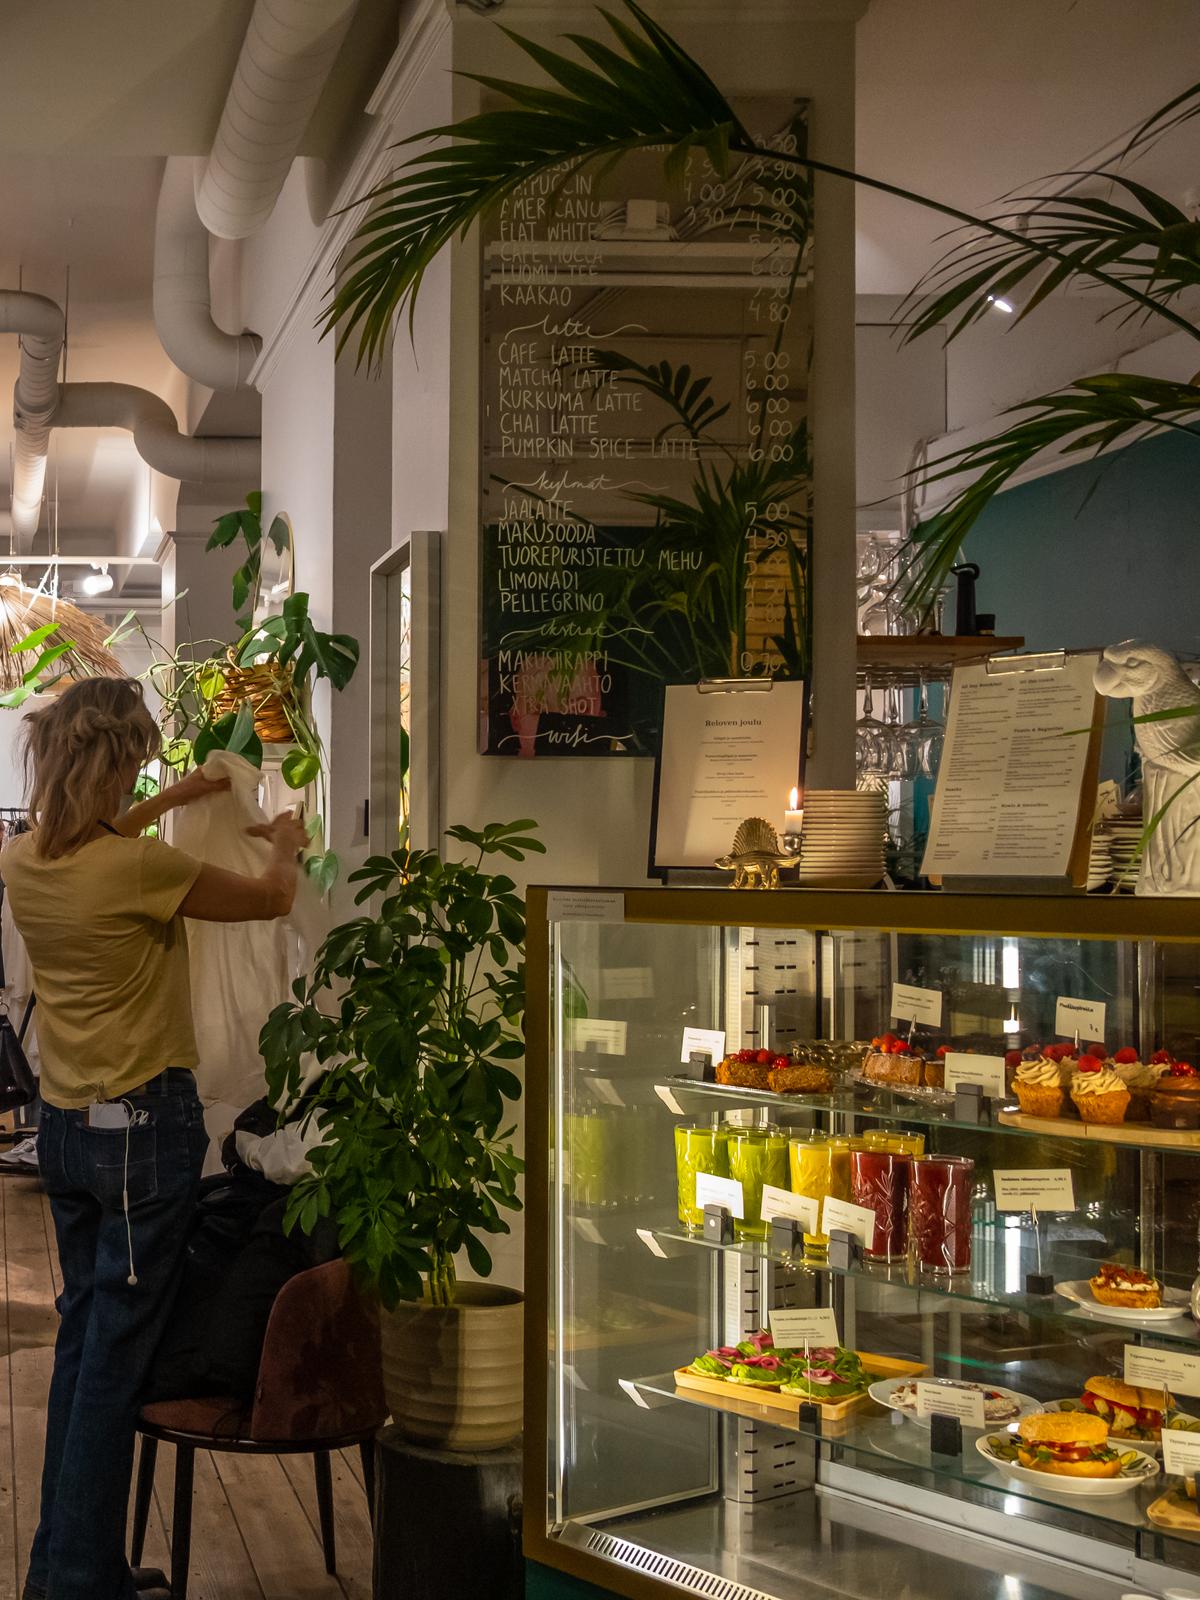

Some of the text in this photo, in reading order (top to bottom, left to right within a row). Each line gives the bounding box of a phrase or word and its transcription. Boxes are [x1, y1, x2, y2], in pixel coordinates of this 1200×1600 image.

[500, 220, 599, 242] FLAT WHITE
[500, 285, 572, 306] KAAKAO
[498, 342, 597, 366] CAFE LATTE
[499, 367, 620, 390] MATCHA LATTE
[499, 389, 643, 413] KURKUMA LATTE
[499, 414, 599, 435] CHAI LATTE
[501, 436, 700, 461] PUMPKIN SPICE LATTE
[498, 522, 596, 545] MAKUSOODA
[498, 545, 703, 571] TUOREPURISTETTU MEHU
[498, 570, 579, 592] LIMONADI
[500, 591, 604, 613] PELLEGRINO
[560, 696, 598, 716] SHOT
